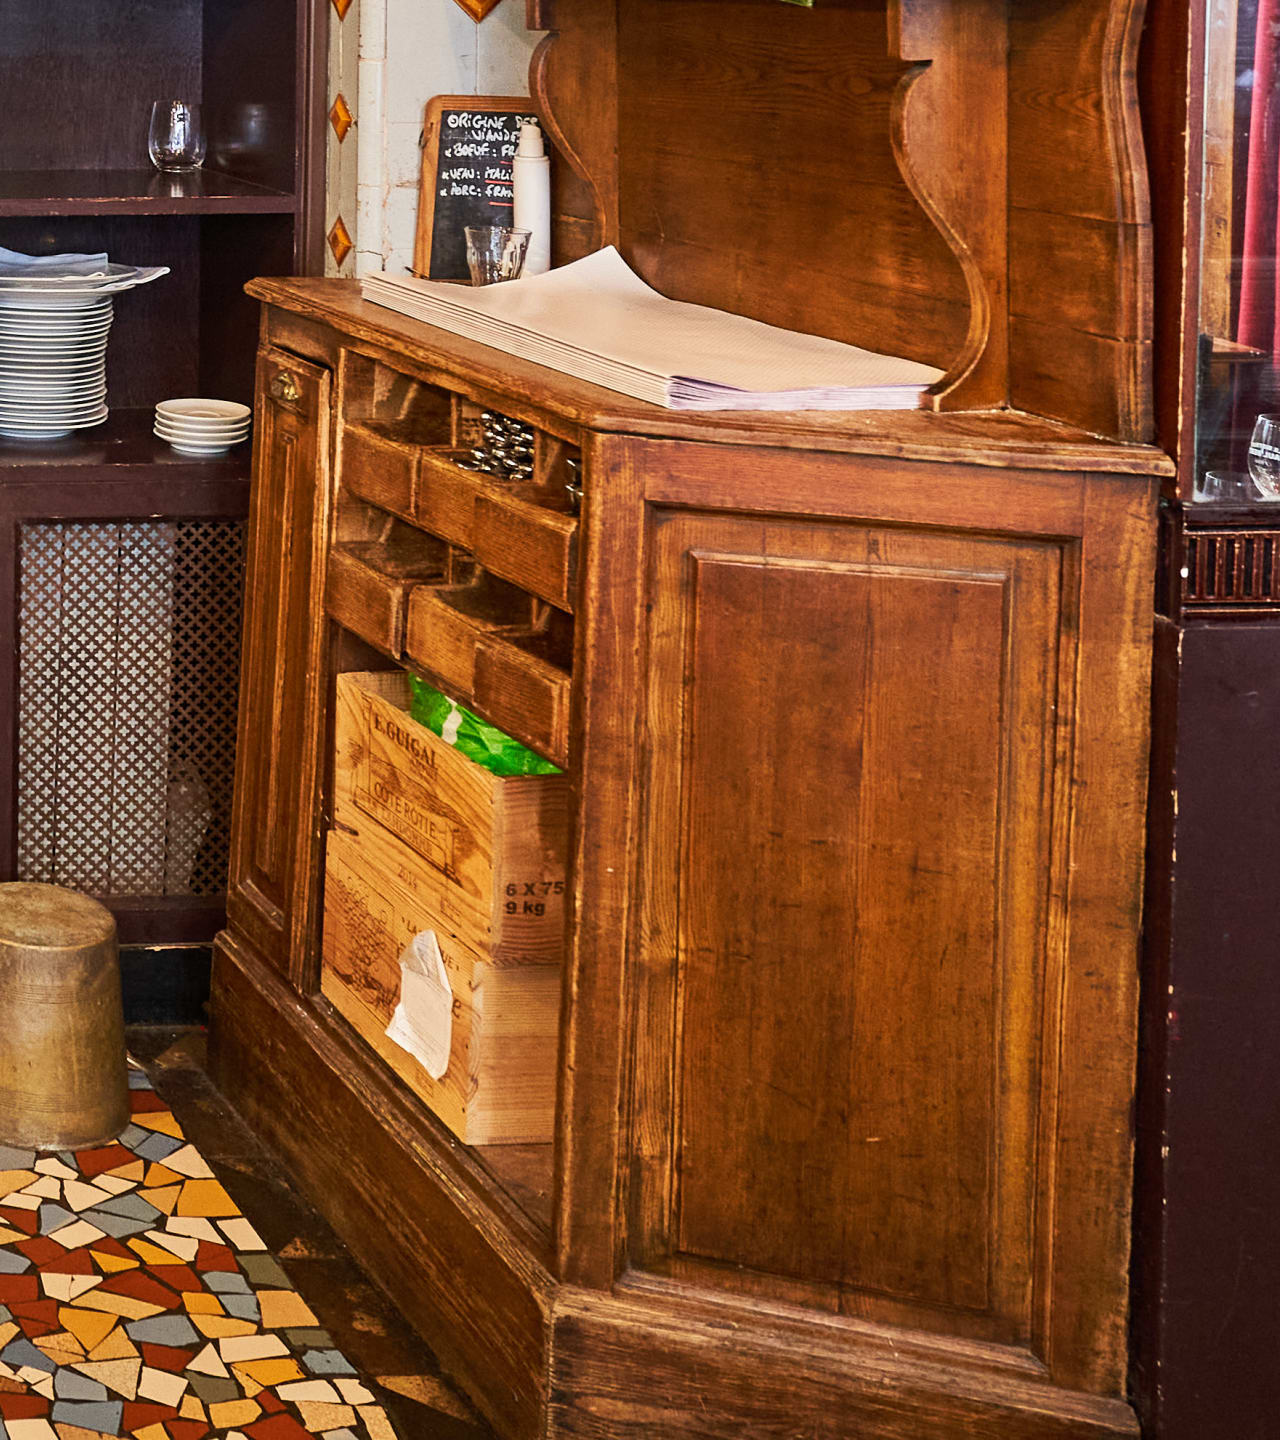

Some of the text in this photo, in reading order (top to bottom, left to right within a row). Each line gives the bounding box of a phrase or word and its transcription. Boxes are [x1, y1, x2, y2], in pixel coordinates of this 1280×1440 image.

[506, 883, 517, 897] 6
[523, 882, 536, 896] X
[505, 900, 546, 917] 9 kg
